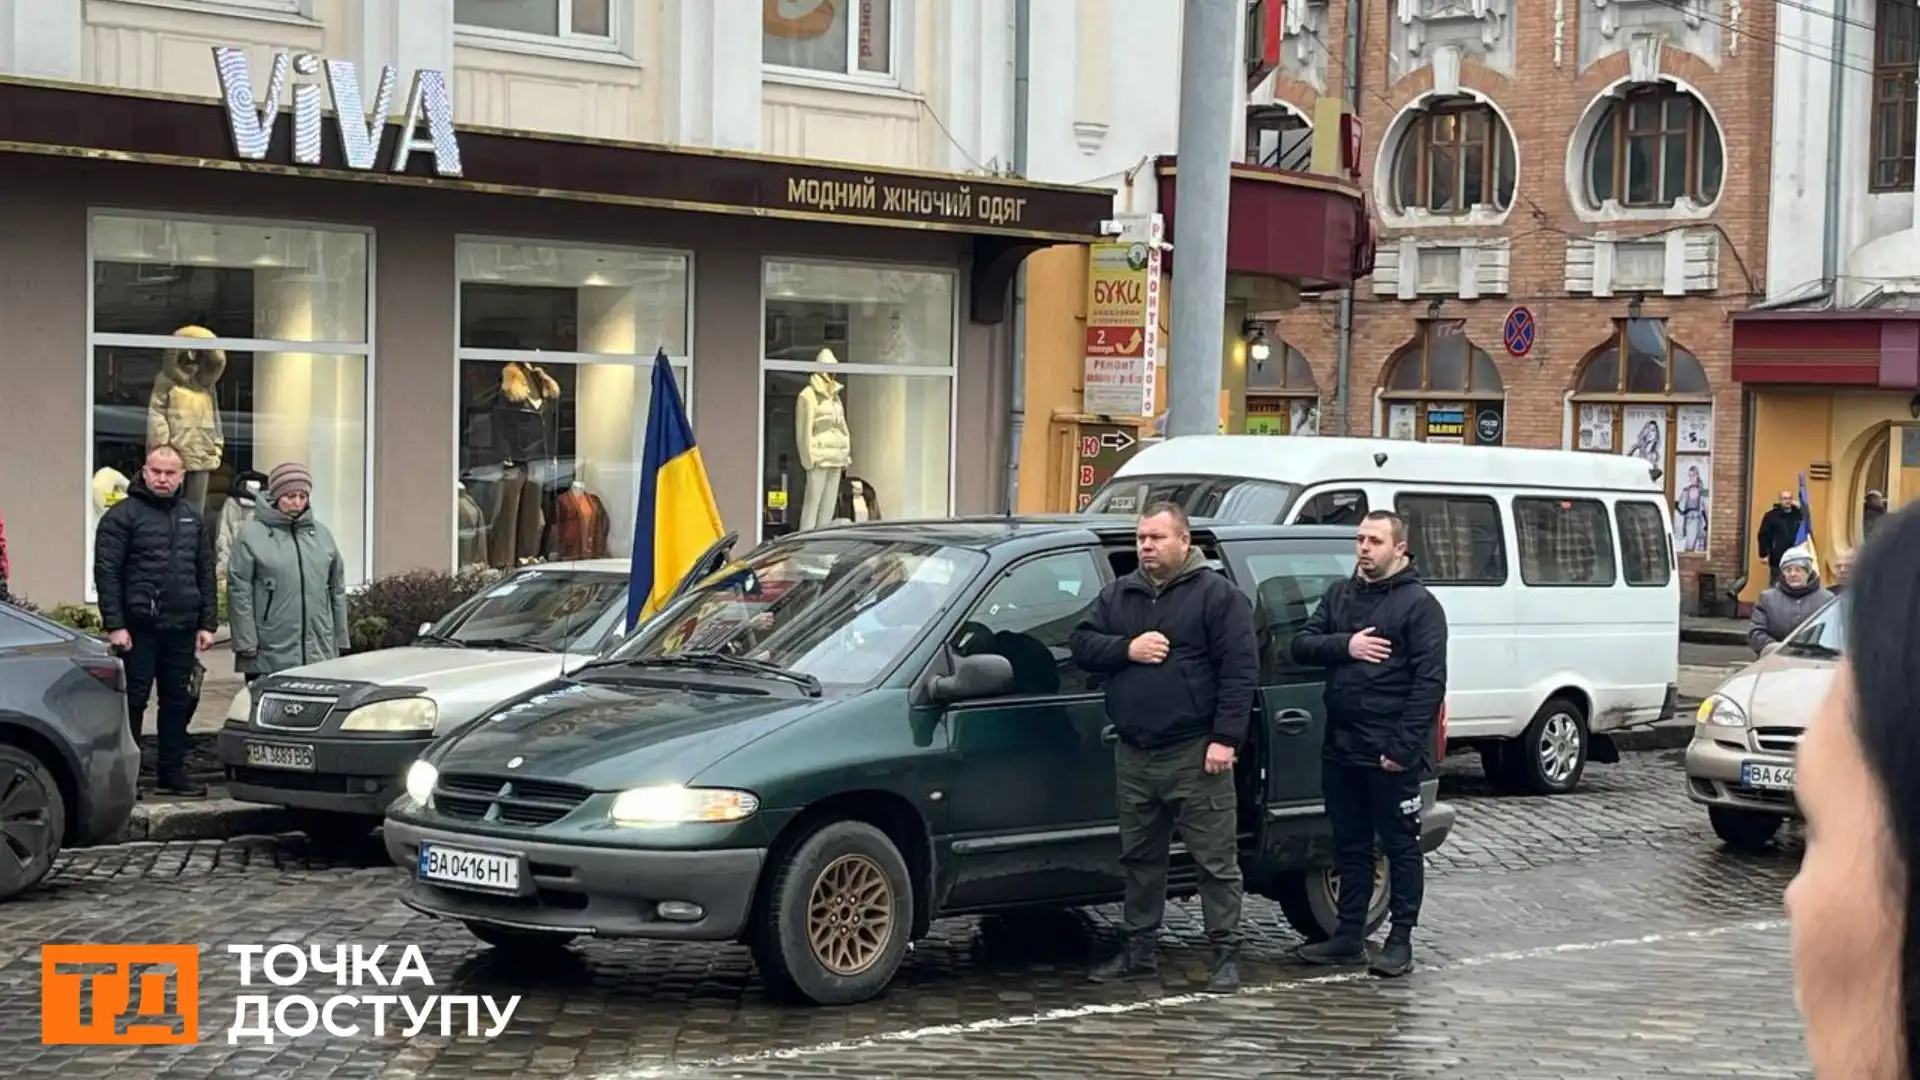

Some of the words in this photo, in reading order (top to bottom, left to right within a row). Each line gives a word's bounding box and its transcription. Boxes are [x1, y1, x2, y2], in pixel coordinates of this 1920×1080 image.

[788, 176, 876, 211] МОДНИЙ
[883, 185, 971, 218] ЖІНОЧИЙ
[977, 195, 1027, 225] ОДЯГ
[1094, 279, 1142, 304] БУКИ
[1097, 330, 1105, 345] 2
[1144, 332, 1155, 411] ЗОЛОТО
